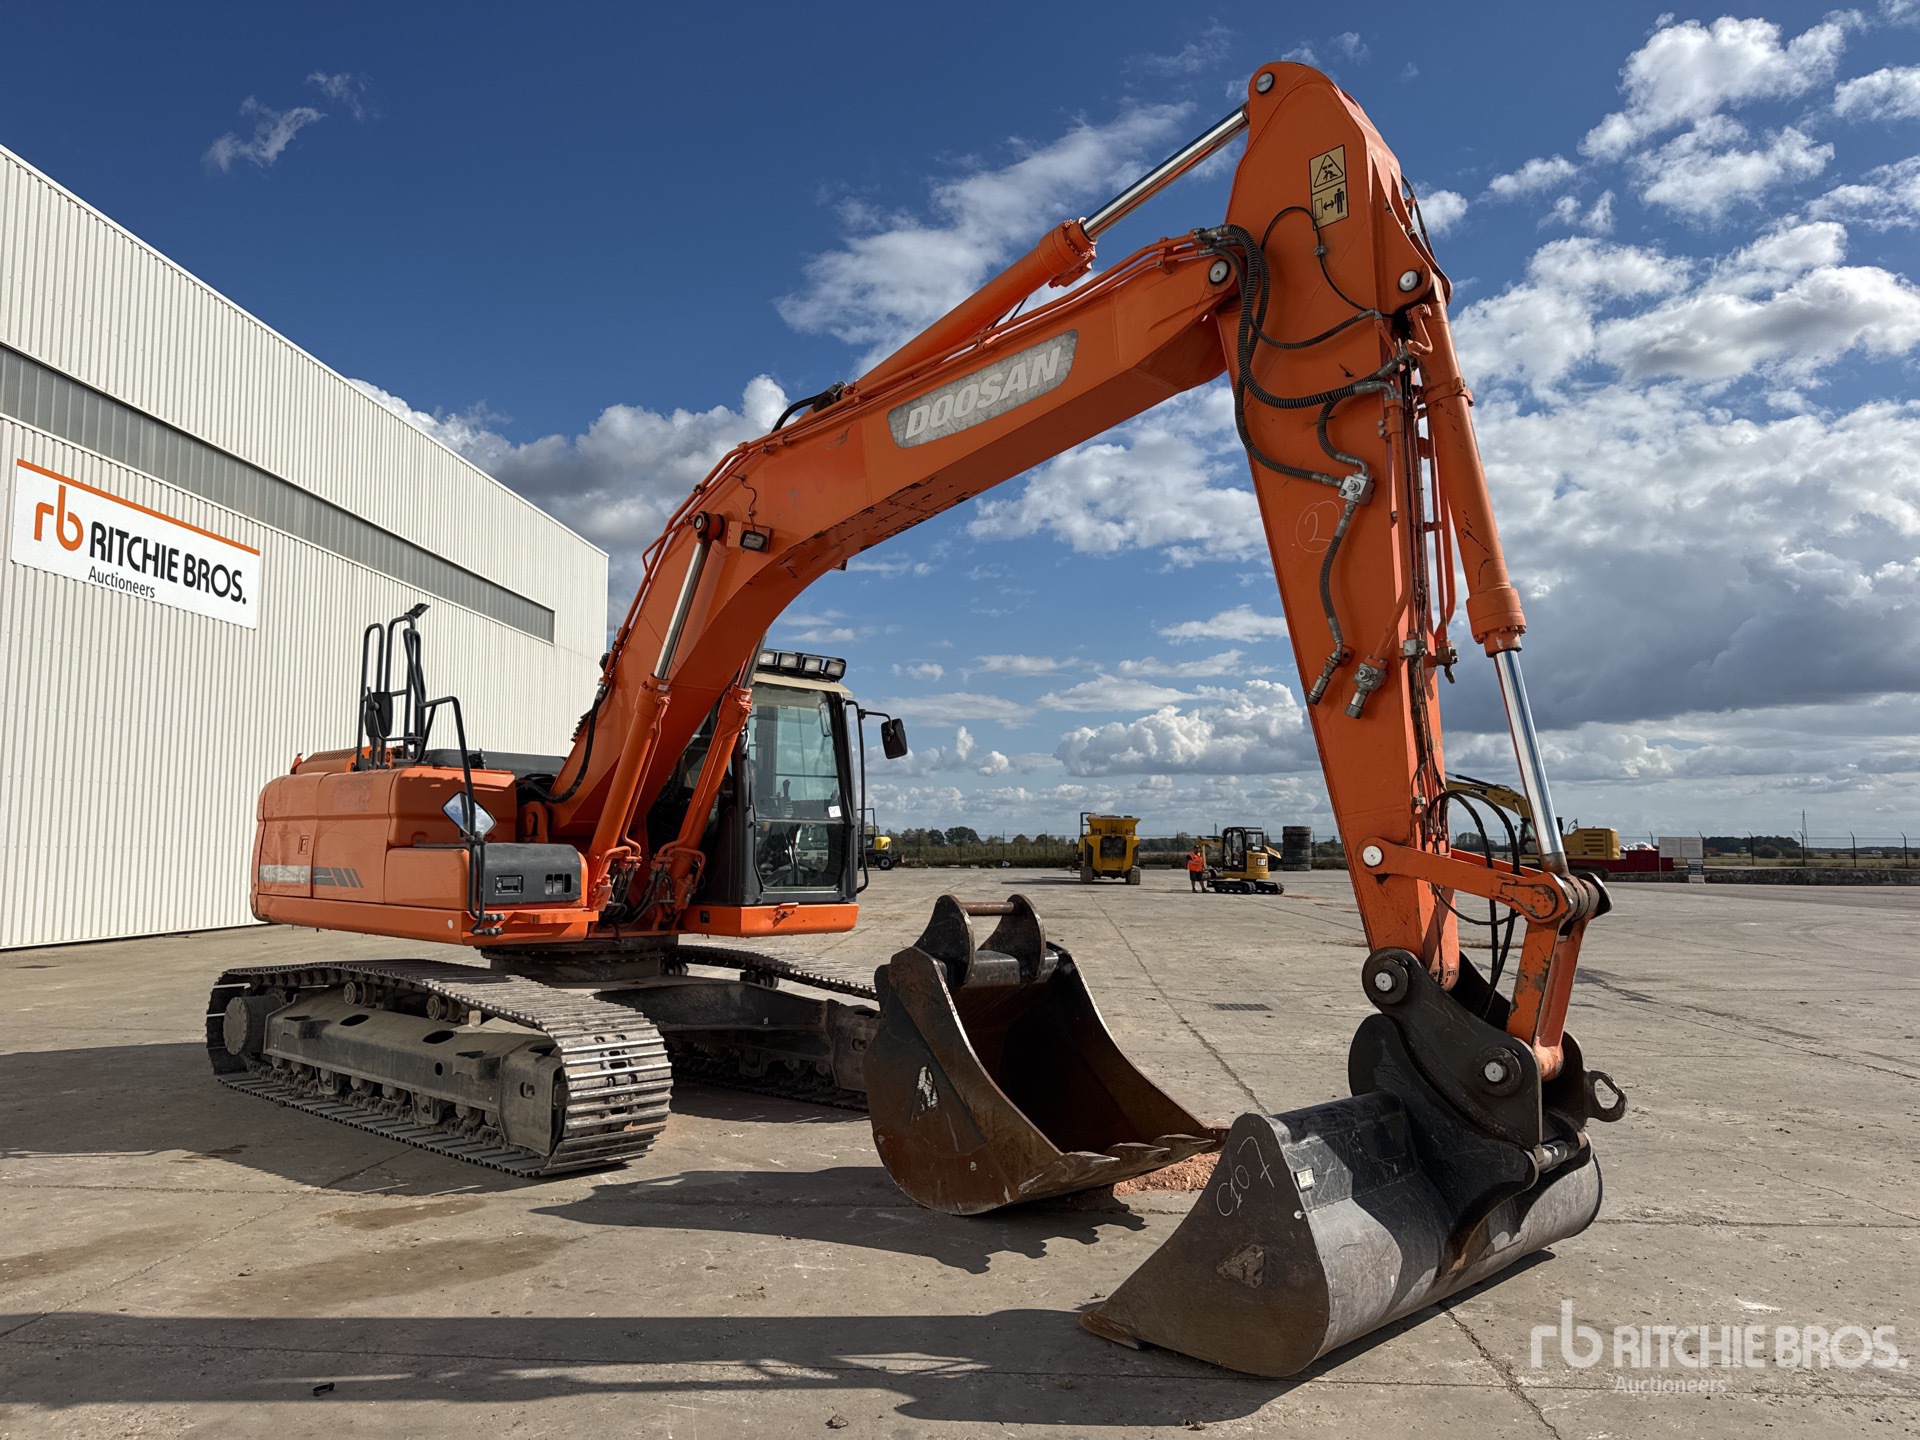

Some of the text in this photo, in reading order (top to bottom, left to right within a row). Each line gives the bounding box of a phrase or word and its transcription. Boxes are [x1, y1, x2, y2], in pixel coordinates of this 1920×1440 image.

[905, 346, 1061, 440] DOOSAN
[33, 484, 84, 551] rb
[88, 565, 155, 598] Auctioneers
[89, 521, 247, 604] RITCHIE BROS.
